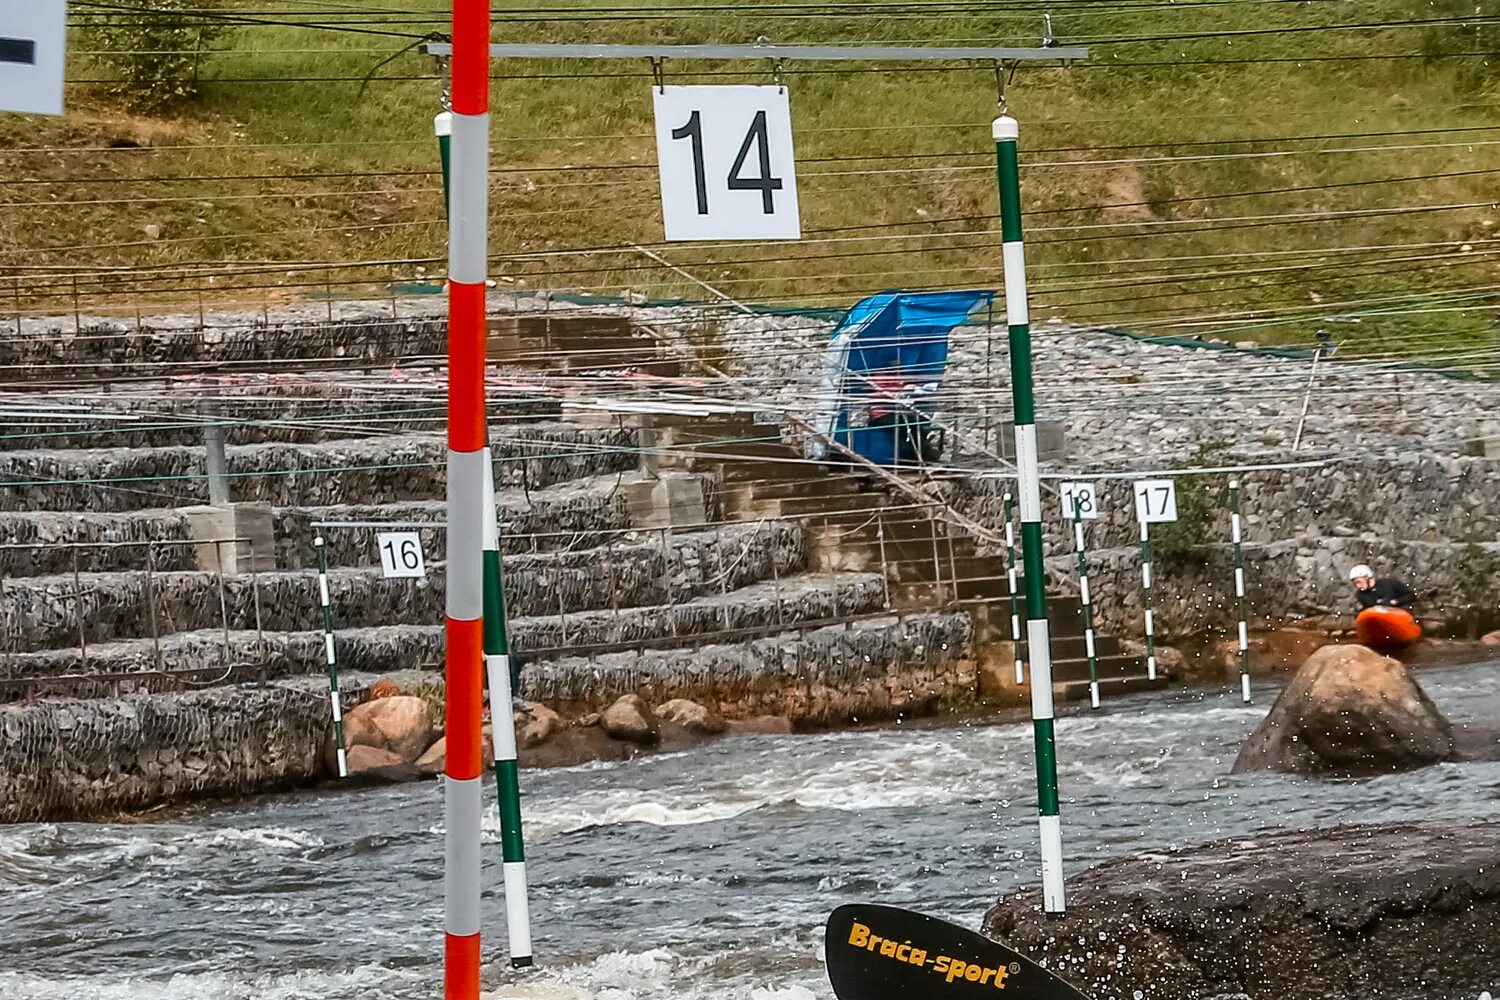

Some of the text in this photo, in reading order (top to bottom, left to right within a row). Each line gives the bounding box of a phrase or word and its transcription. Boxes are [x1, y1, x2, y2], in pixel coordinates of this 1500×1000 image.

[671, 110, 783, 215] 14
[1064, 488, 1093, 513] 18
[1138, 486, 1171, 516] 17
[382, 540, 419, 570] 16
